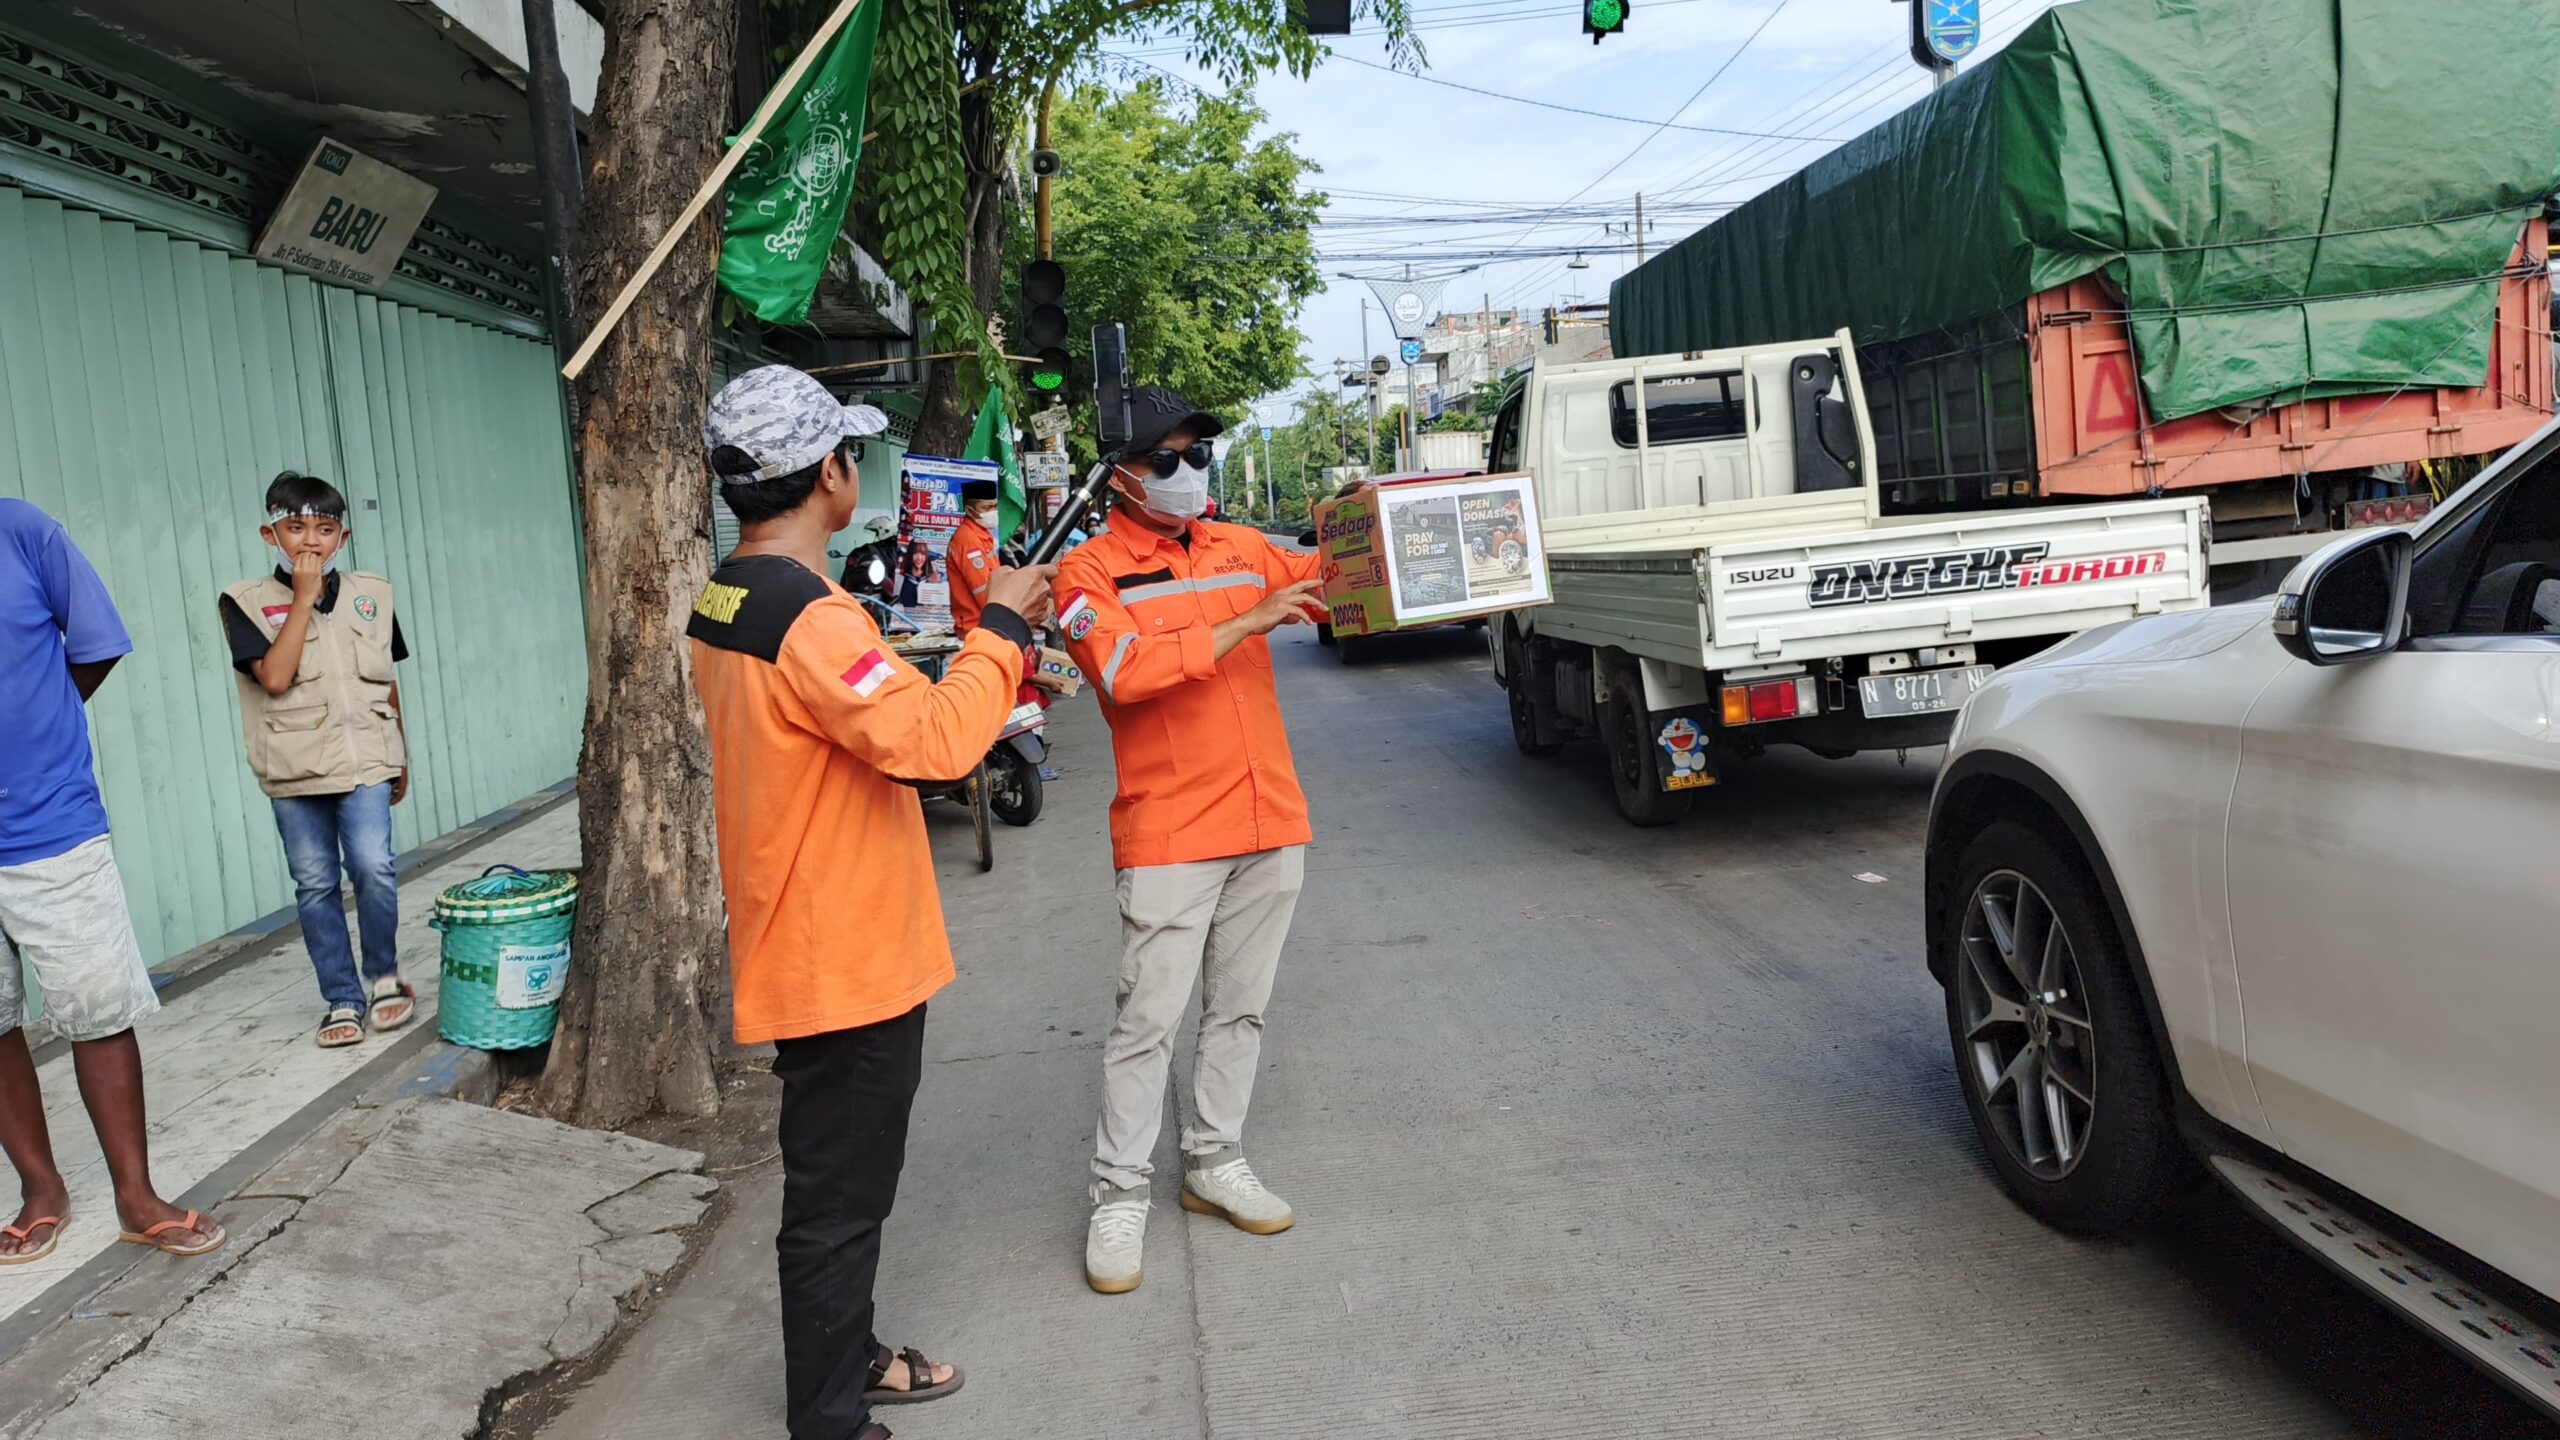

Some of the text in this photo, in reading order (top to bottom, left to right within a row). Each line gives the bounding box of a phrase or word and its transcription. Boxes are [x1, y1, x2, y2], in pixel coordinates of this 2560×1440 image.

[310, 196, 389, 255] BARU
[1657, 376, 1697, 388] JOLO
[908, 489, 965, 514] JEPA
[1462, 498, 1490, 511] OPEN
[1320, 514, 1376, 544] Sedaap
[1405, 530, 1434, 546] PRAY
[1406, 544, 1431, 558] FOR
[1226, 554, 1242, 566] ABI
[1374, 564, 1383, 580] 8
[1730, 566, 1795, 585] ISUZU
[1864, 680, 1879, 703] N
[1894, 673, 1942, 700] 8771
[1665, 770, 1716, 792] BULL
